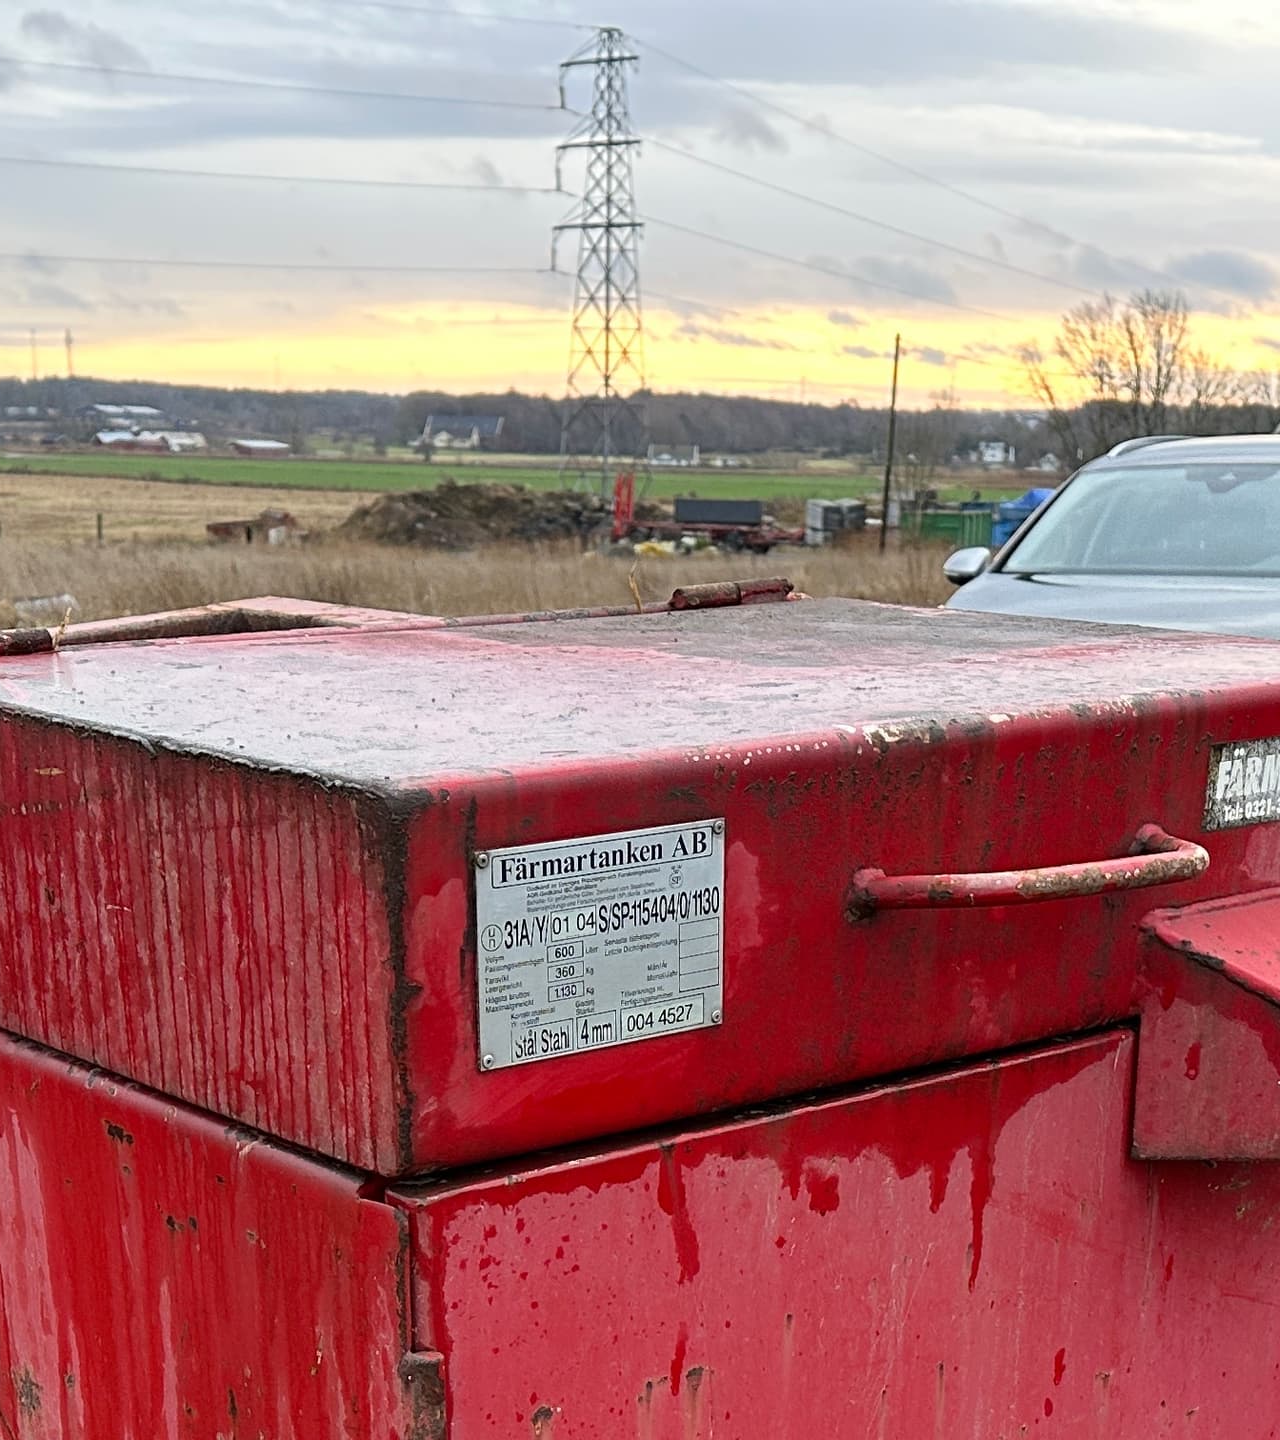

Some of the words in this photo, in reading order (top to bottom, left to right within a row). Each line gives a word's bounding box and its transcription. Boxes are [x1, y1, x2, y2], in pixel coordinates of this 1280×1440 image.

[500, 841, 663, 883] Färmartanken
[672, 831, 707, 857] AB
[552, 916, 570, 935] 01
[577, 912, 595, 931] 04
[554, 946, 575, 959] 600
[554, 965, 575, 979] 360
[627, 1011, 654, 1032] 004
[658, 1004, 693, 1026] 4527
[541, 1025, 570, 1053] Stahl
[581, 1019, 589, 1044] 4
[592, 1022, 613, 1043] mm
